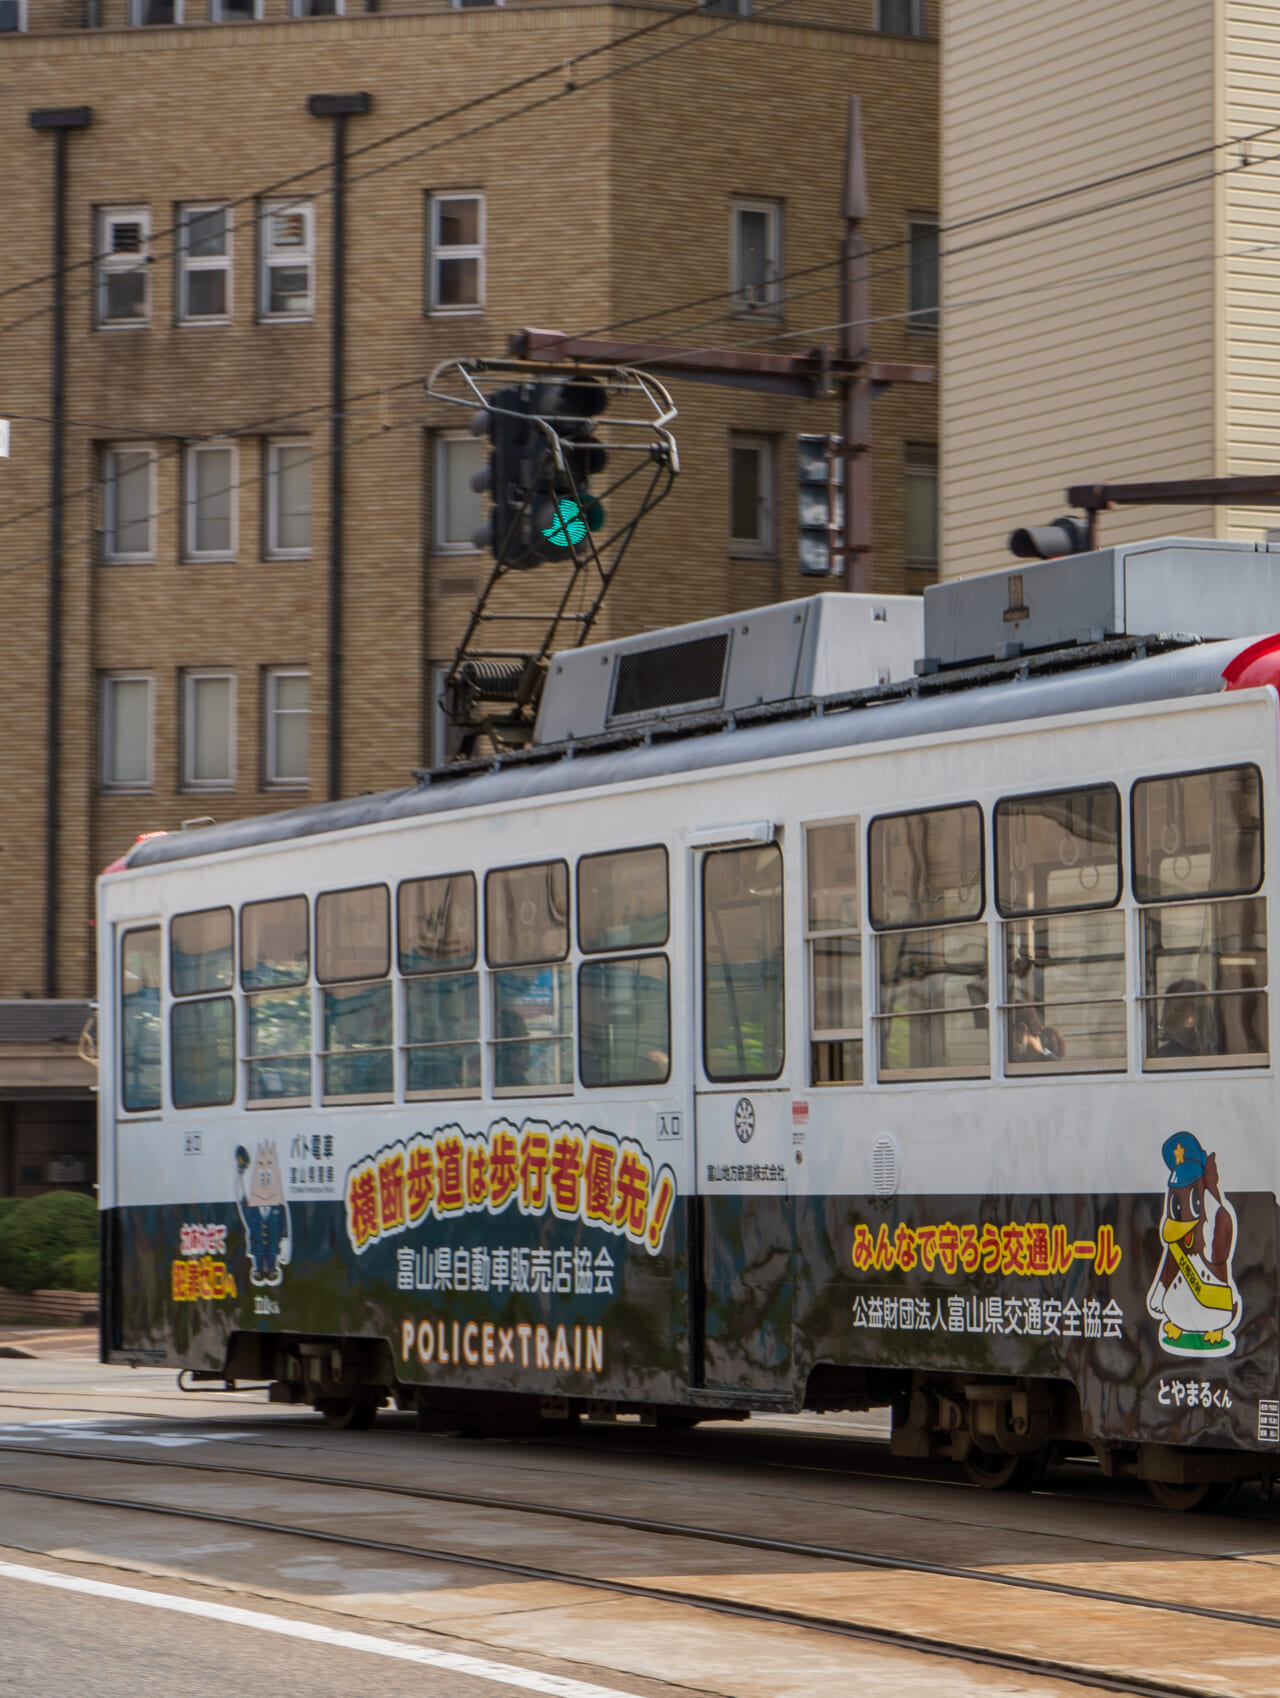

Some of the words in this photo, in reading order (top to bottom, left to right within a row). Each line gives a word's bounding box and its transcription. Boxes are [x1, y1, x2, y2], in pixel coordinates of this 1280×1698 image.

[659, 1116, 681, 1136] 入口
[349, 1130, 672, 1247] 横断歩道は歩行者優先!
[397, 1246, 615, 1294] 富山県自動車販売店協会
[852, 1221, 1122, 1276] みんなで守ろう交通ルール
[852, 1295, 1124, 1339] 公益財団法人富山県交通安全協会
[1158, 1379, 1233, 1408] とやまるくん
